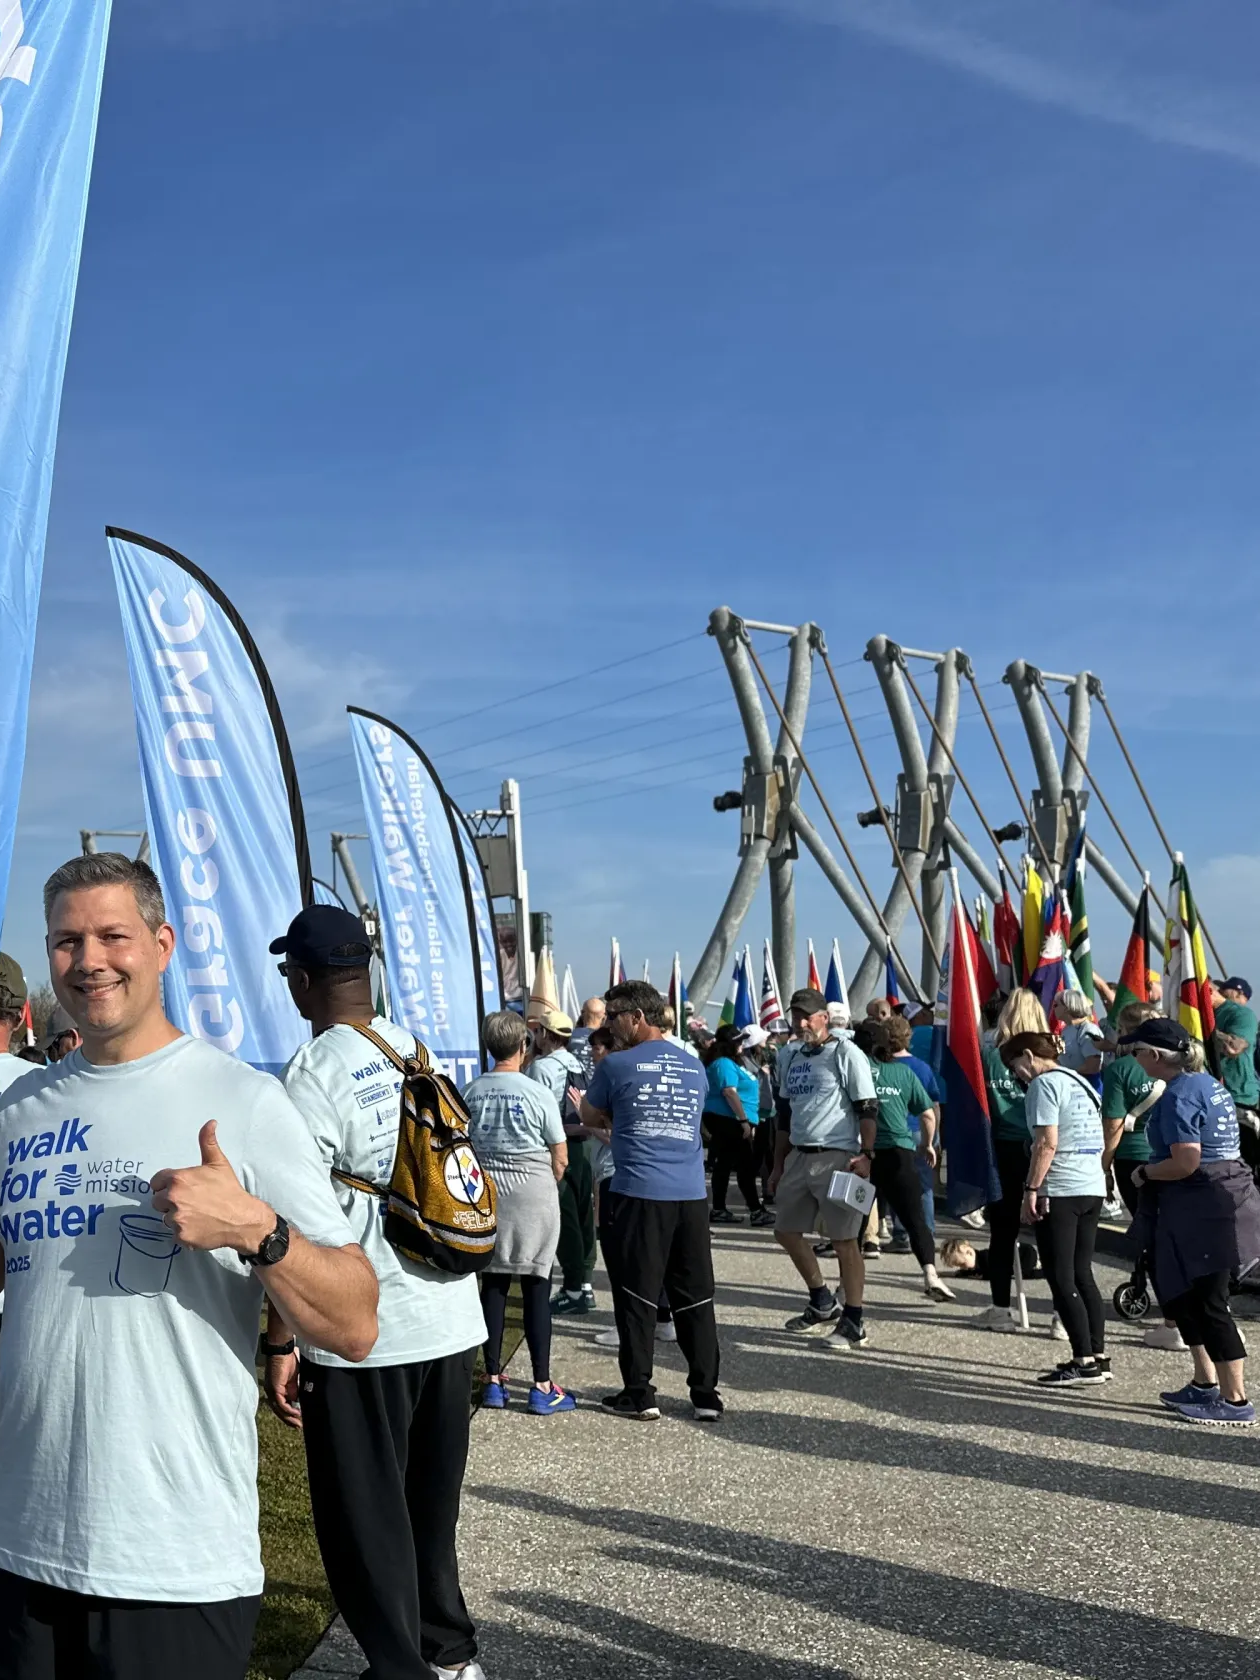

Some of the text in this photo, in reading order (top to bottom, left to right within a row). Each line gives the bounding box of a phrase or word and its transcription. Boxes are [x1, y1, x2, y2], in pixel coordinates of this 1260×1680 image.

[350, 1060, 384, 1081] walk
[382, 1057, 397, 1071] fo
[876, 1086, 901, 1096] crew
[8, 1118, 93, 1165] walk
[87, 1158, 144, 1174] water
[0, 1168, 47, 1206] for
[85, 1175, 155, 1194] missio
[0, 1200, 105, 1246] water
[6, 1256, 31, 1274] 2025
